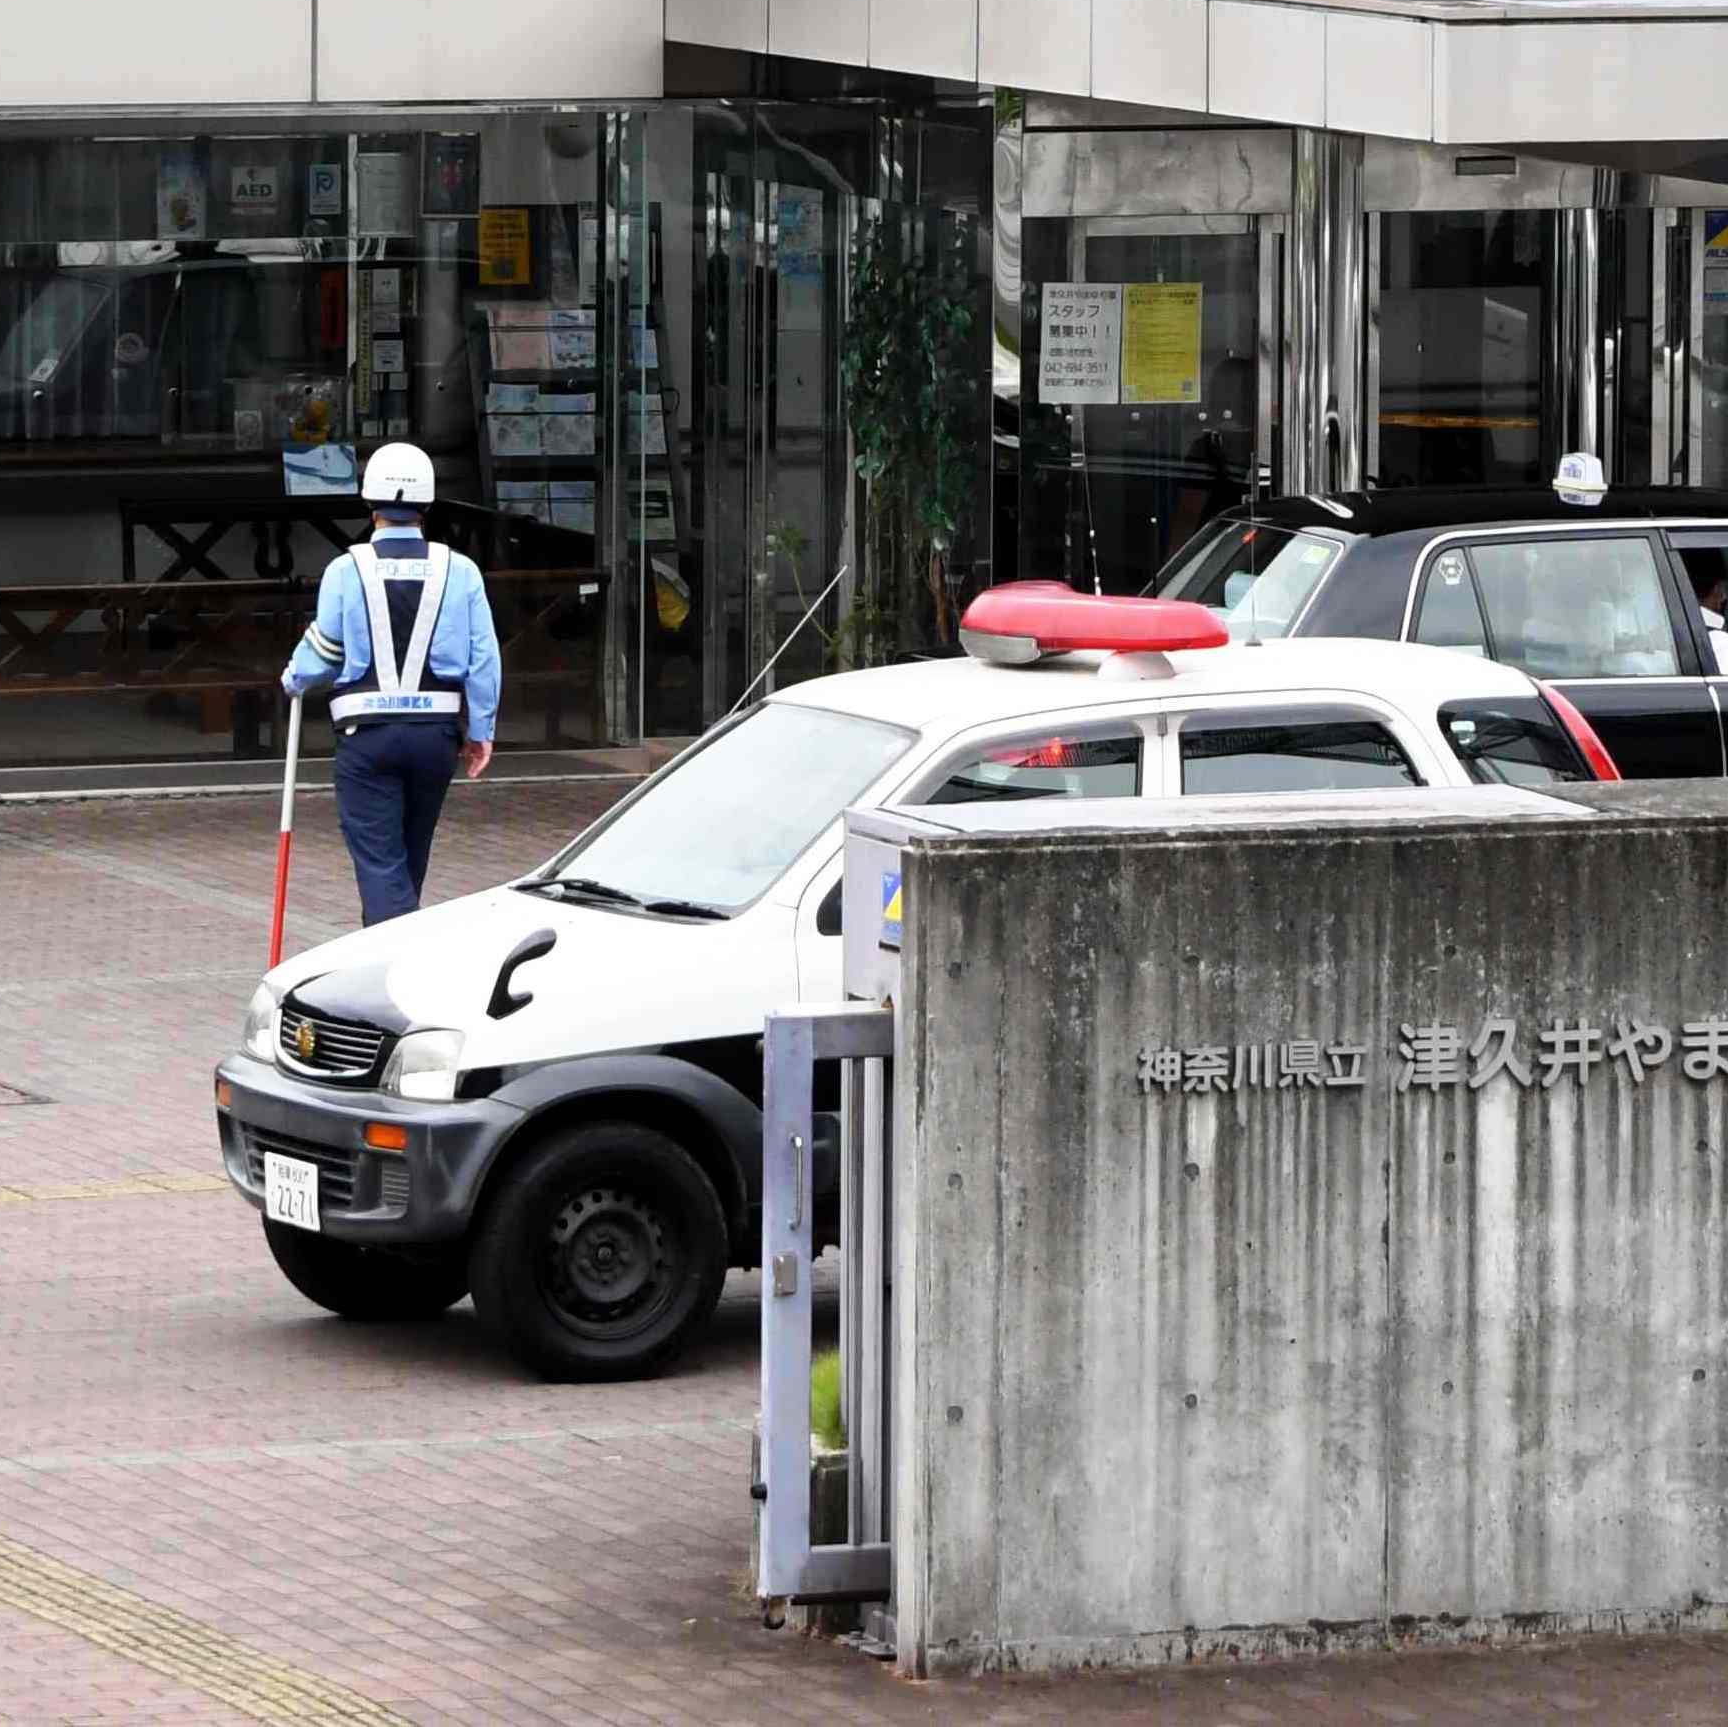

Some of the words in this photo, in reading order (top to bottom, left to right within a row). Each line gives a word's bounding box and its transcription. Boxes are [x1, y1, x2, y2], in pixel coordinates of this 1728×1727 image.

[236, 184, 273, 198] AED
[1049, 304, 1100, 318] スタッフ
[375, 562, 434, 578] POLICE
[1137, 1040, 1369, 1094] 神奈川県立
